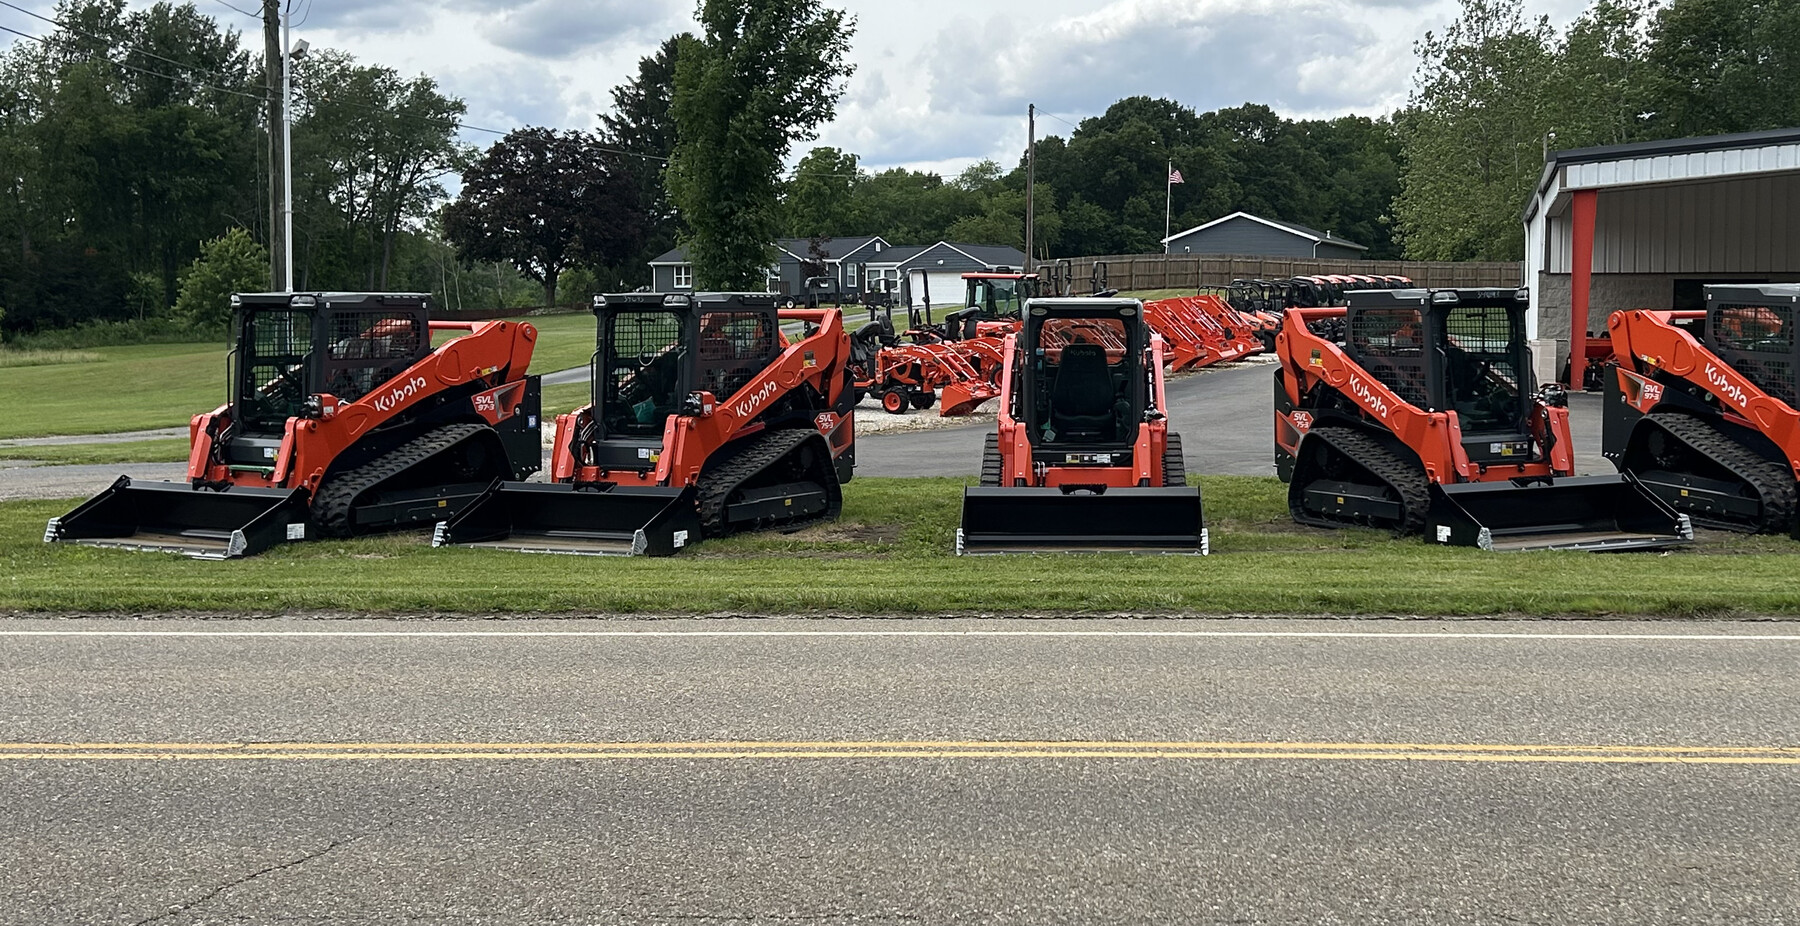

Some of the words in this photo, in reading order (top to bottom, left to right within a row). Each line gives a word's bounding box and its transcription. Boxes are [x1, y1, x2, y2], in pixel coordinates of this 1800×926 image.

[1644, 384, 1660, 393] SVL
[1704, 362, 1748, 408] Kubota
[374, 376, 427, 412] Kubota
[735, 380, 777, 417] Kubota
[1349, 373, 1388, 418] Kubota
[1644, 392, 1660, 400] 97-3
[475, 395, 495, 404] SVL
[818, 414, 833, 423] SVL
[1293, 412, 1308, 421] SVL
[1296, 421, 1309, 429] 75-3
